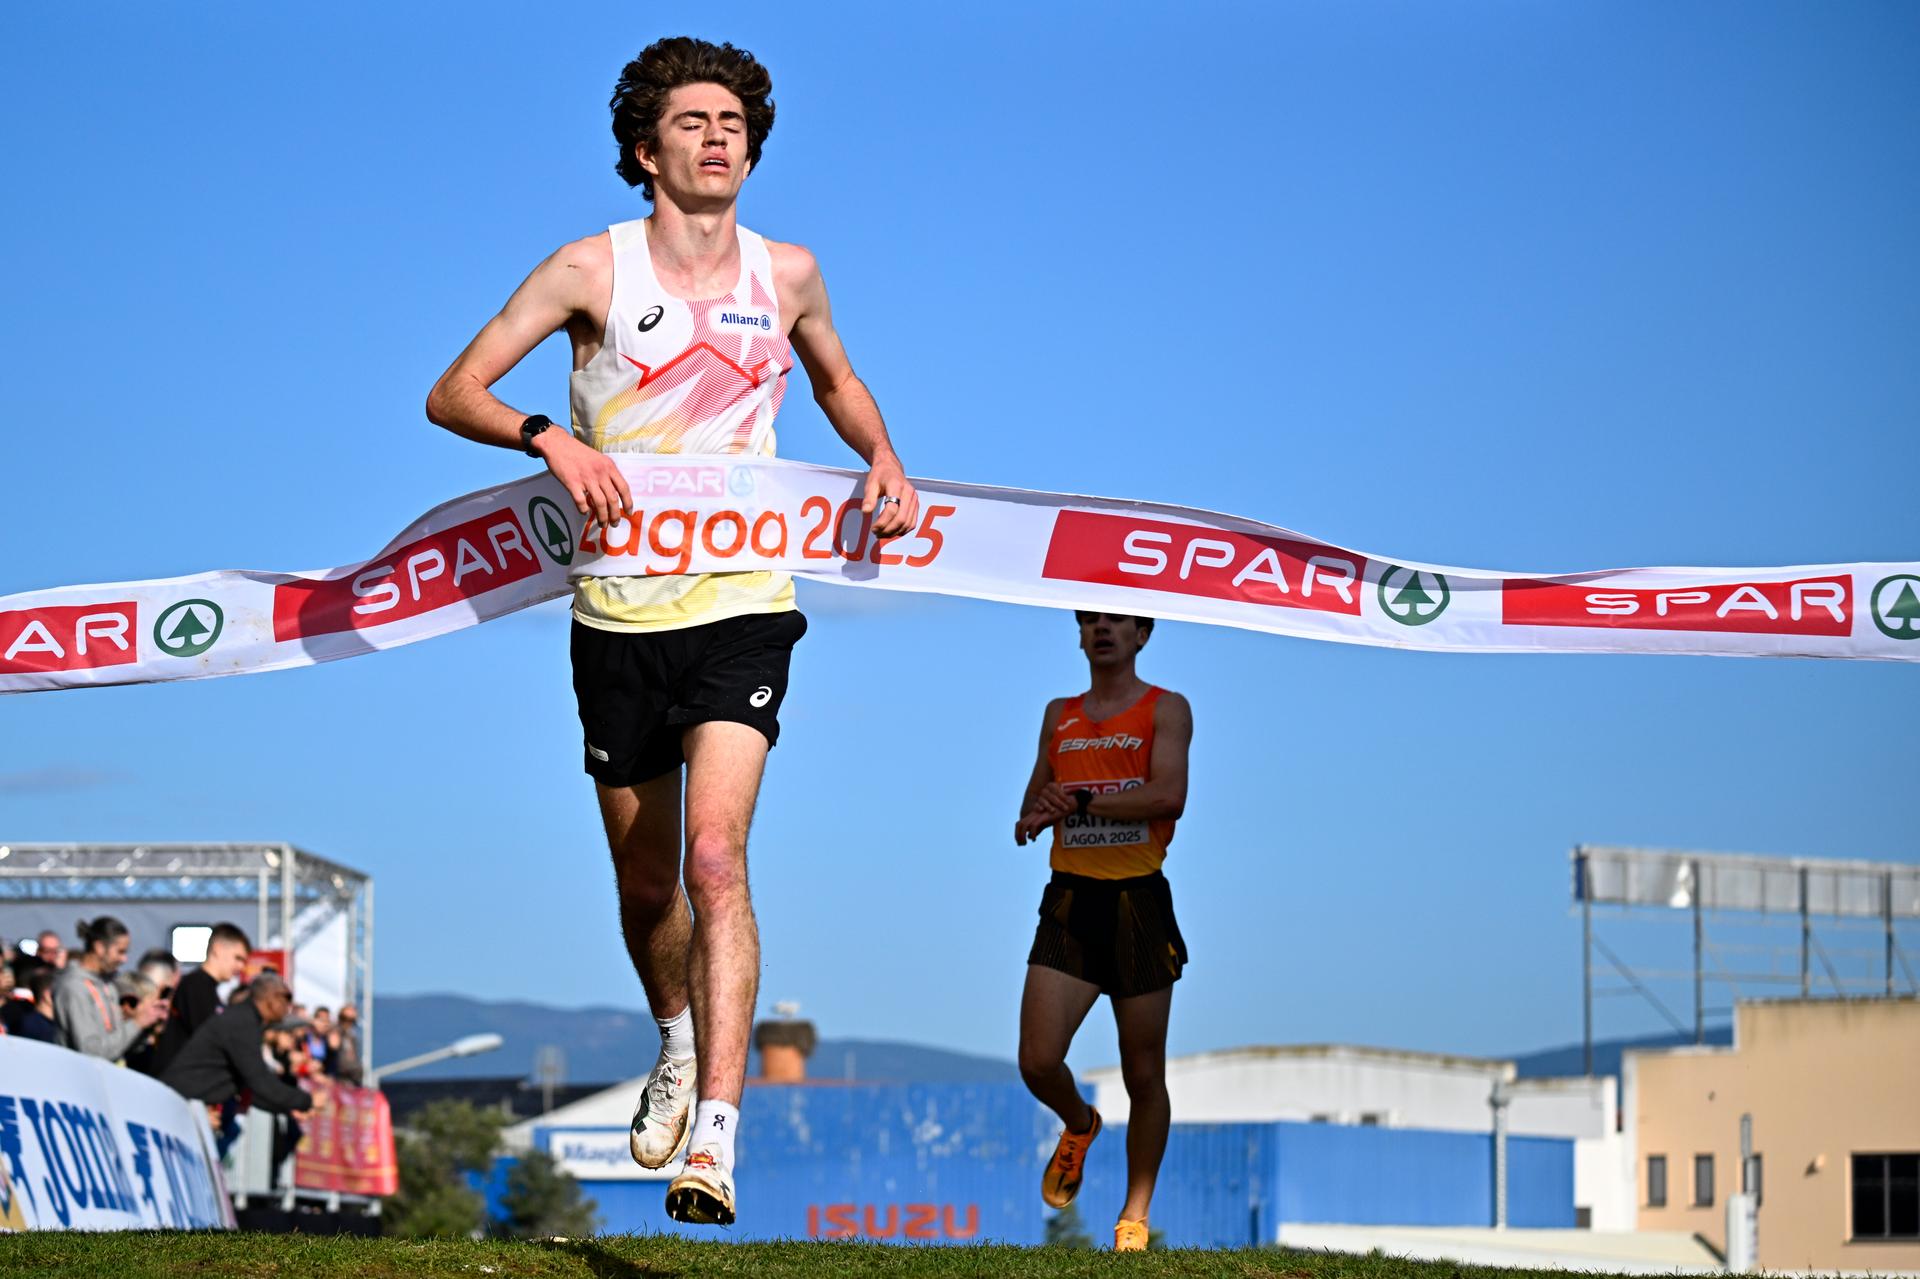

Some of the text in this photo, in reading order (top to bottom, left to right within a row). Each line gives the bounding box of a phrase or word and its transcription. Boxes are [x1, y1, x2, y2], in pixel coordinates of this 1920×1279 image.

[721, 313, 759, 326] Allianz
[800, 495, 957, 568] 2025
[352, 521, 533, 615] SPAR
[1118, 529, 1357, 604] SPAR
[1585, 582, 1846, 623] SPAR
[1058, 733, 1144, 754] ESPAÑA
[1064, 830, 1141, 847] LAGOA 2025
[807, 1204, 980, 1239] ISUZU
